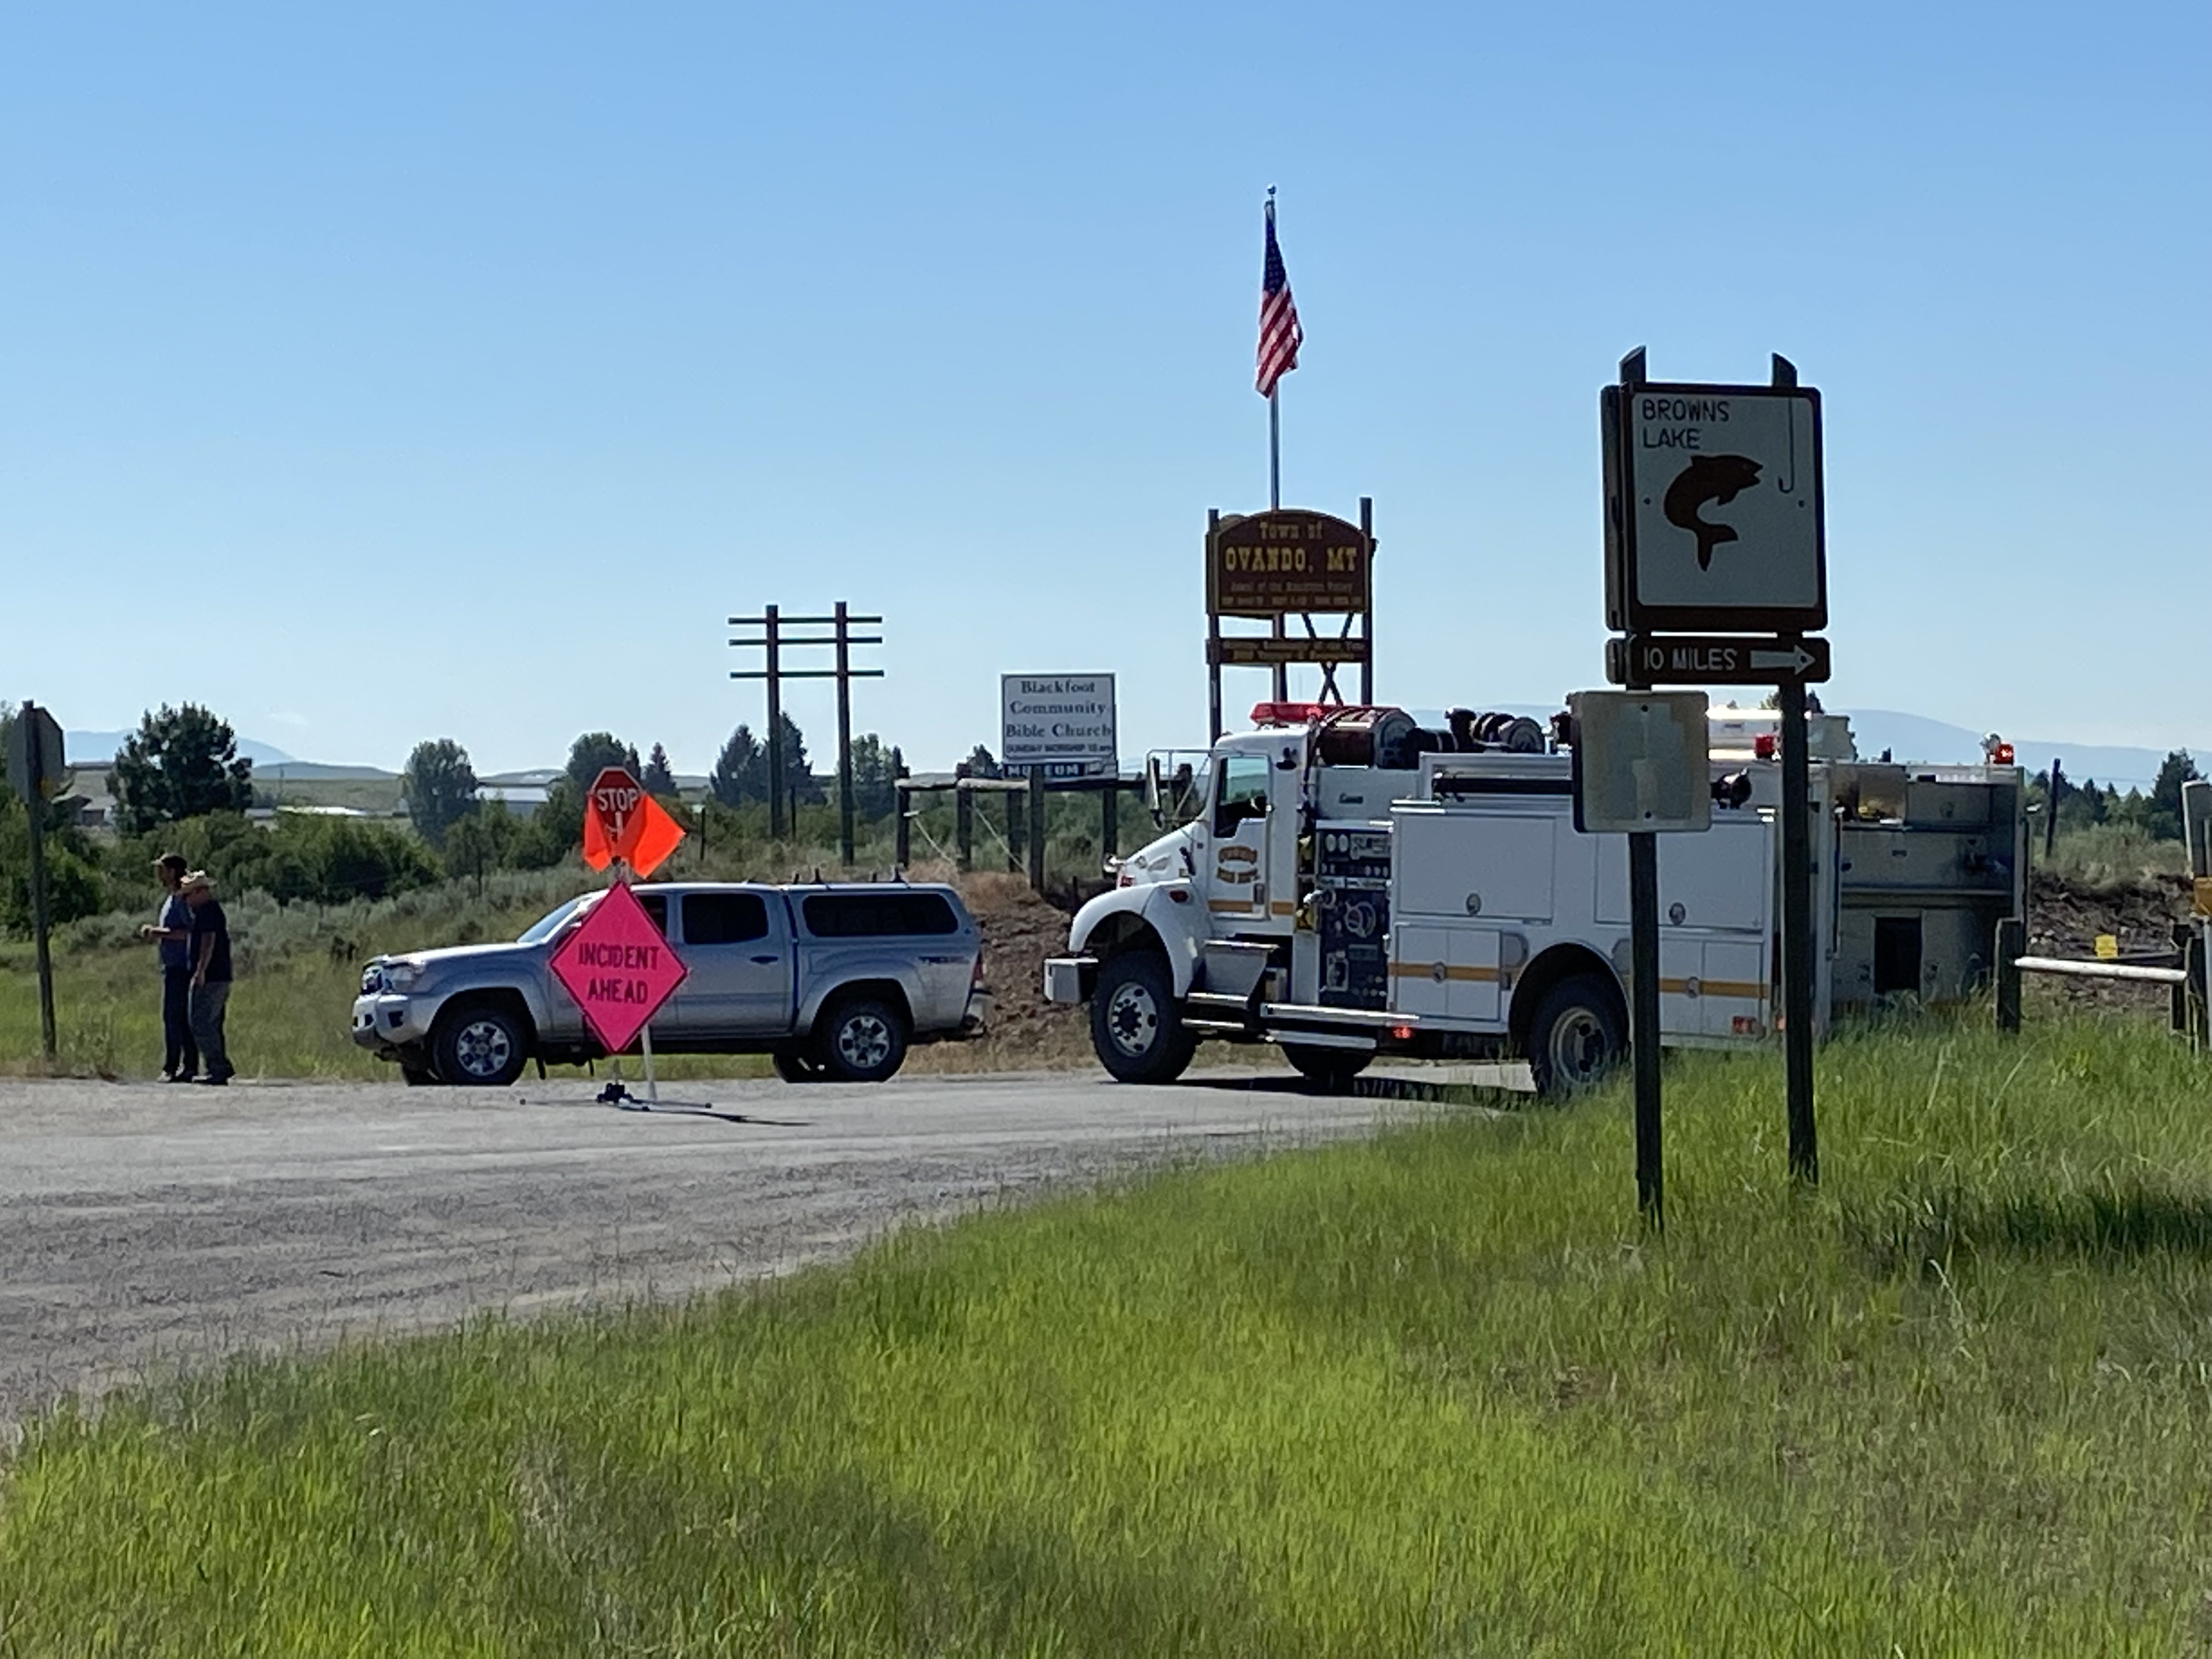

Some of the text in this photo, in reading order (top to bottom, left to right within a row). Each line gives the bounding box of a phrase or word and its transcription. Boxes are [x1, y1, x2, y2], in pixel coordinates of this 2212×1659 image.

[1642, 399, 1729, 422] BROWNS
[1643, 428, 1701, 450] LAKE
[1260, 521, 1299, 539] Town
[1225, 546, 1357, 573] OVANDO, MT
[1644, 647, 1738, 671] 10 MILES
[1020, 679, 1095, 694] Blackfoot
[1010, 700, 1106, 717] Community
[1006, 723, 1112, 738] Bible Church
[1007, 764, 1079, 777] MUEUM
[596, 788, 639, 812] STOP
[579, 943, 661, 971] INCIDENT
[587, 978, 649, 1005] AHEAD
